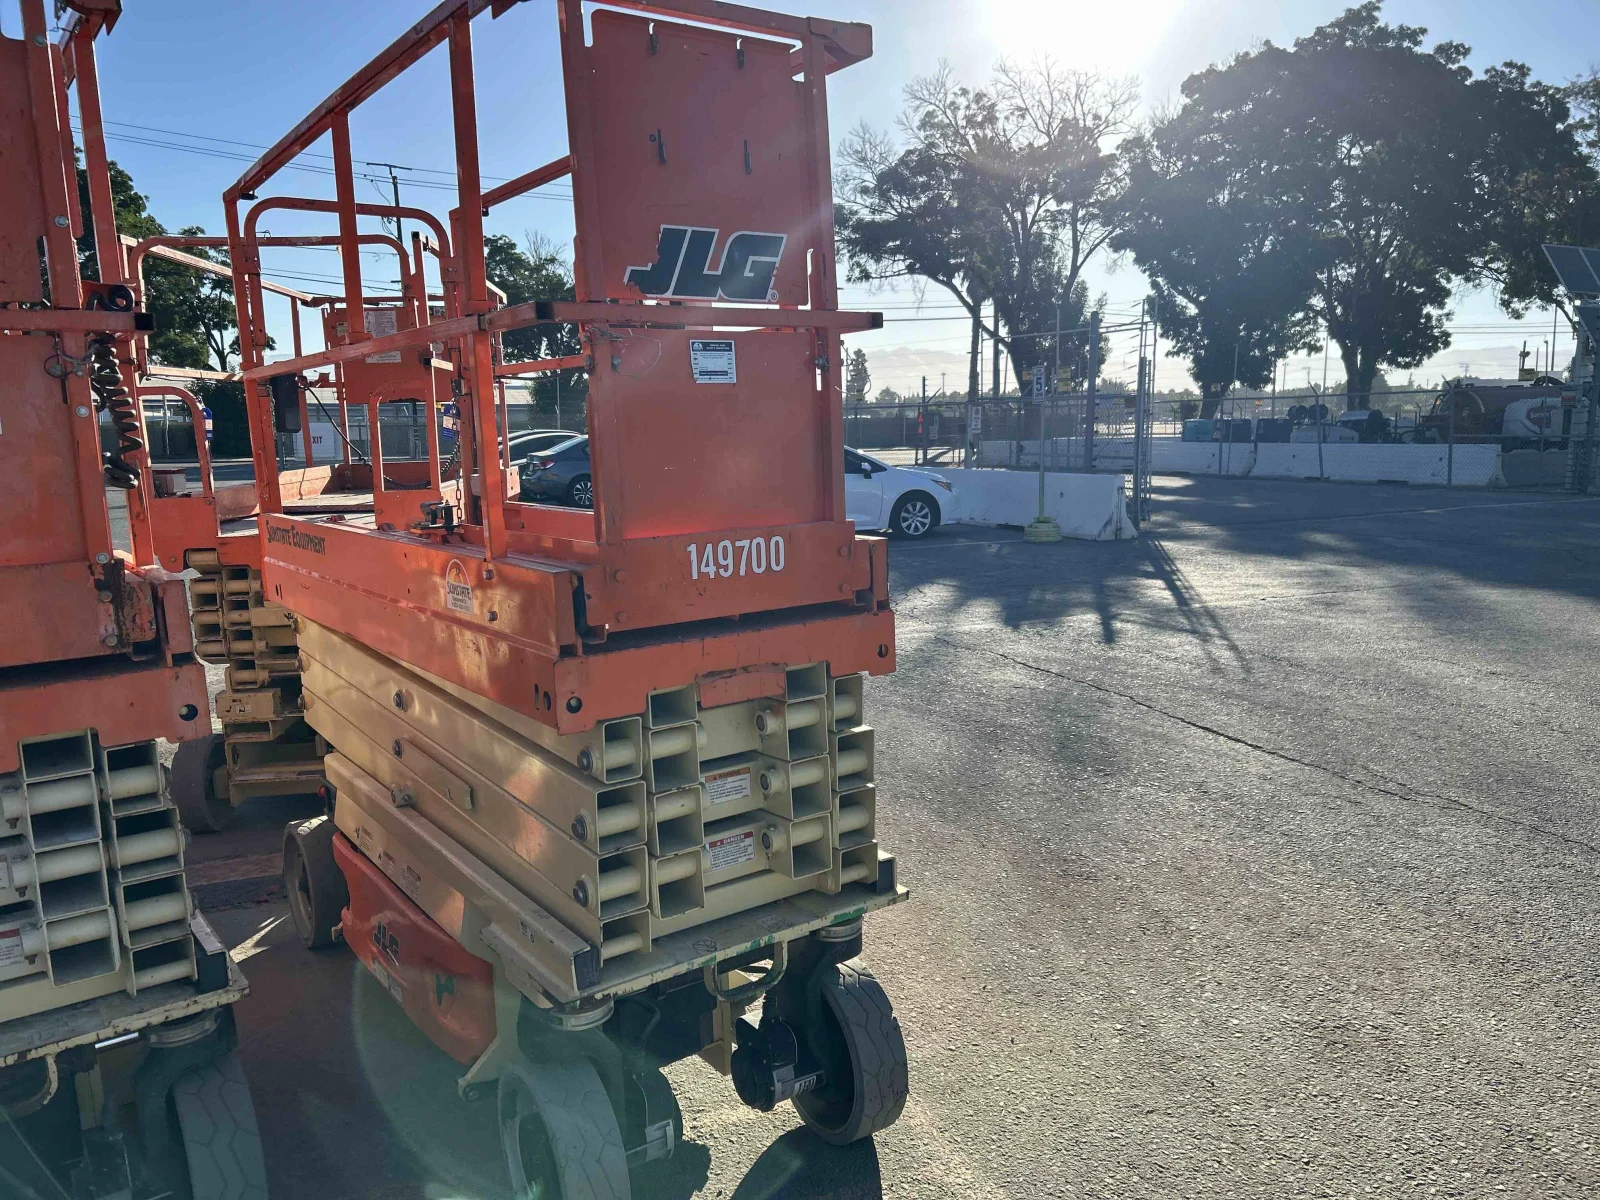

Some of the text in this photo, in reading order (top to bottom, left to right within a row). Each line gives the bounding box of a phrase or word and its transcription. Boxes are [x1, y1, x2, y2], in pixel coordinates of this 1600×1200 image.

[623, 223, 788, 302] JLG
[1035, 376, 1043, 392] 5
[311, 436, 323, 445] XIT
[686, 535, 786, 580] 149700
